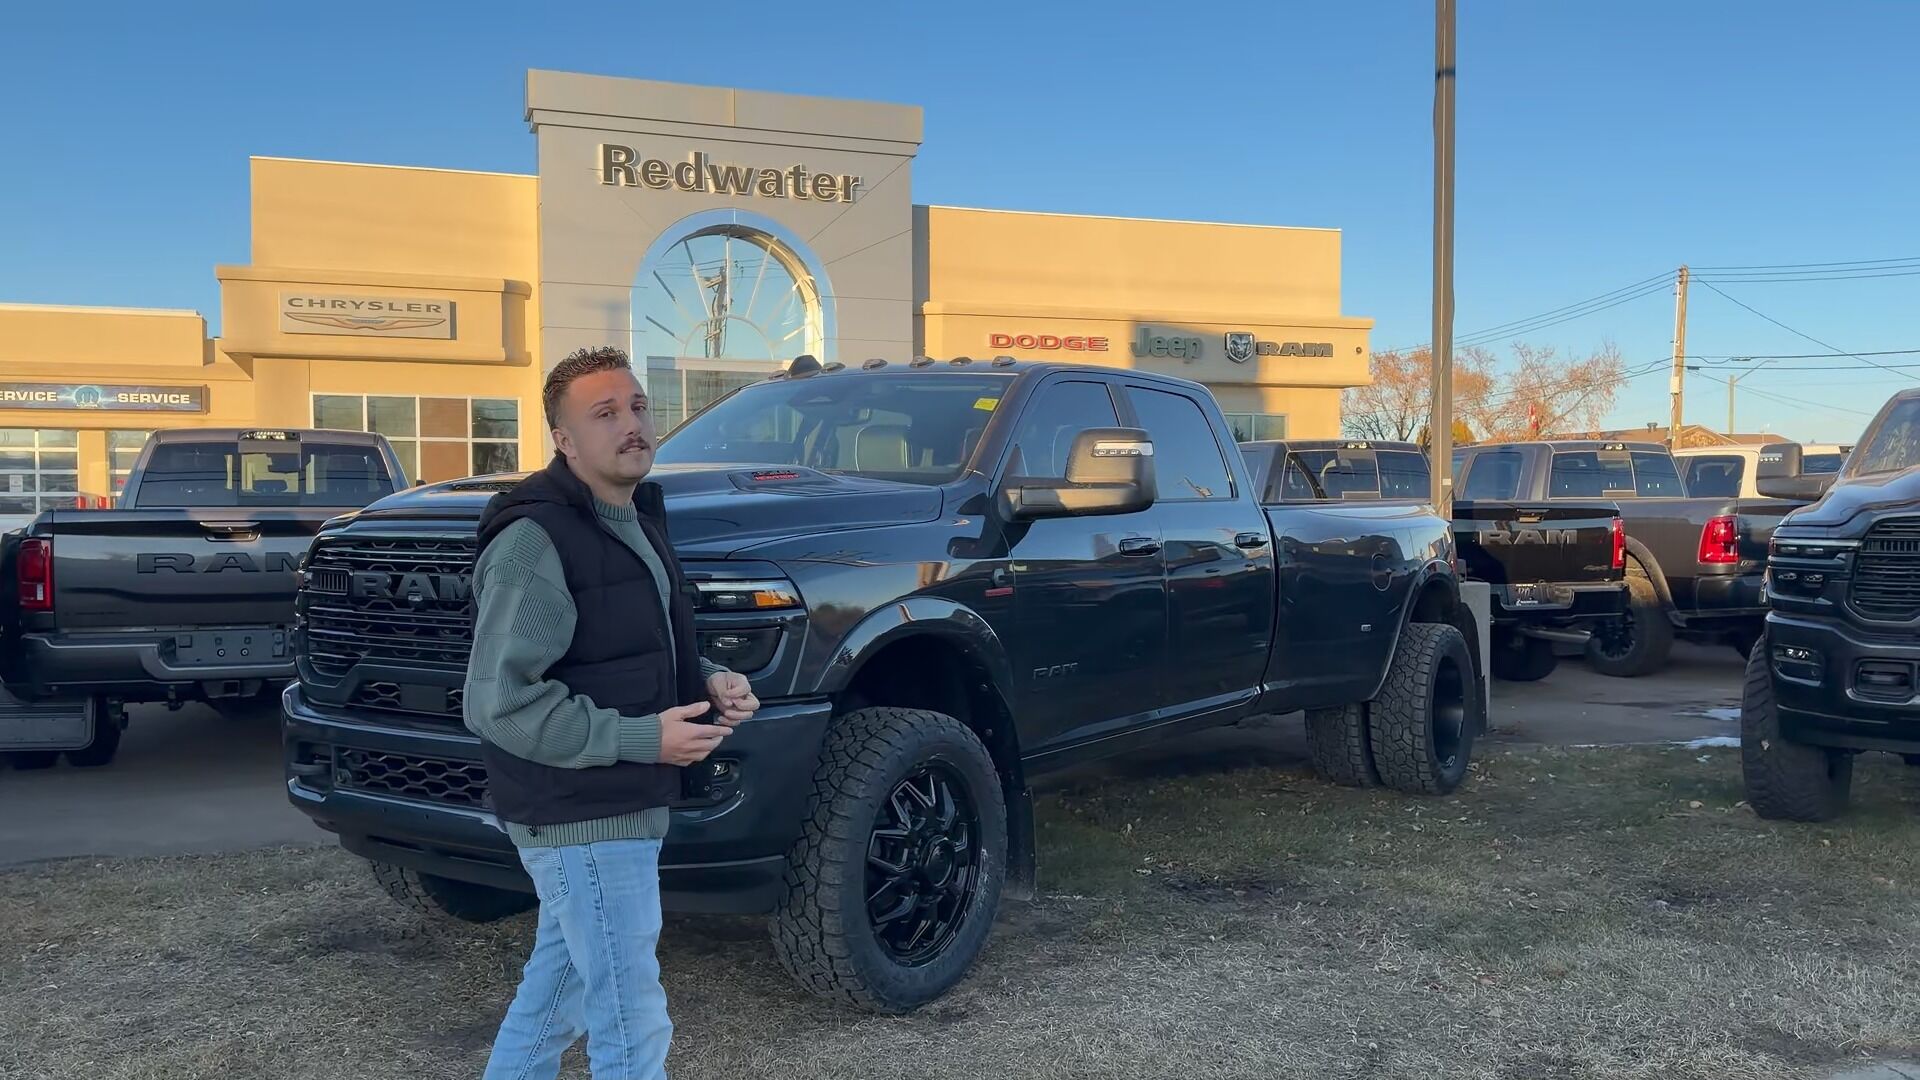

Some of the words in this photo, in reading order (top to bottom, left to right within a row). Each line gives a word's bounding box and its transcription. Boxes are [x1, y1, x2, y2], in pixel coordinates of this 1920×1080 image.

[600, 143, 861, 202] Redwater
[287, 297, 443, 314] CHRYSLER
[989, 333, 1108, 351] DODGE
[1129, 327, 1203, 364] Jeep
[1256, 340, 1334, 358] RAM
[117, 392, 190, 405] SERVICE
[1479, 529, 1578, 545] RAM
[136, 551, 307, 574] RAM
[352, 571, 473, 601] RAM
